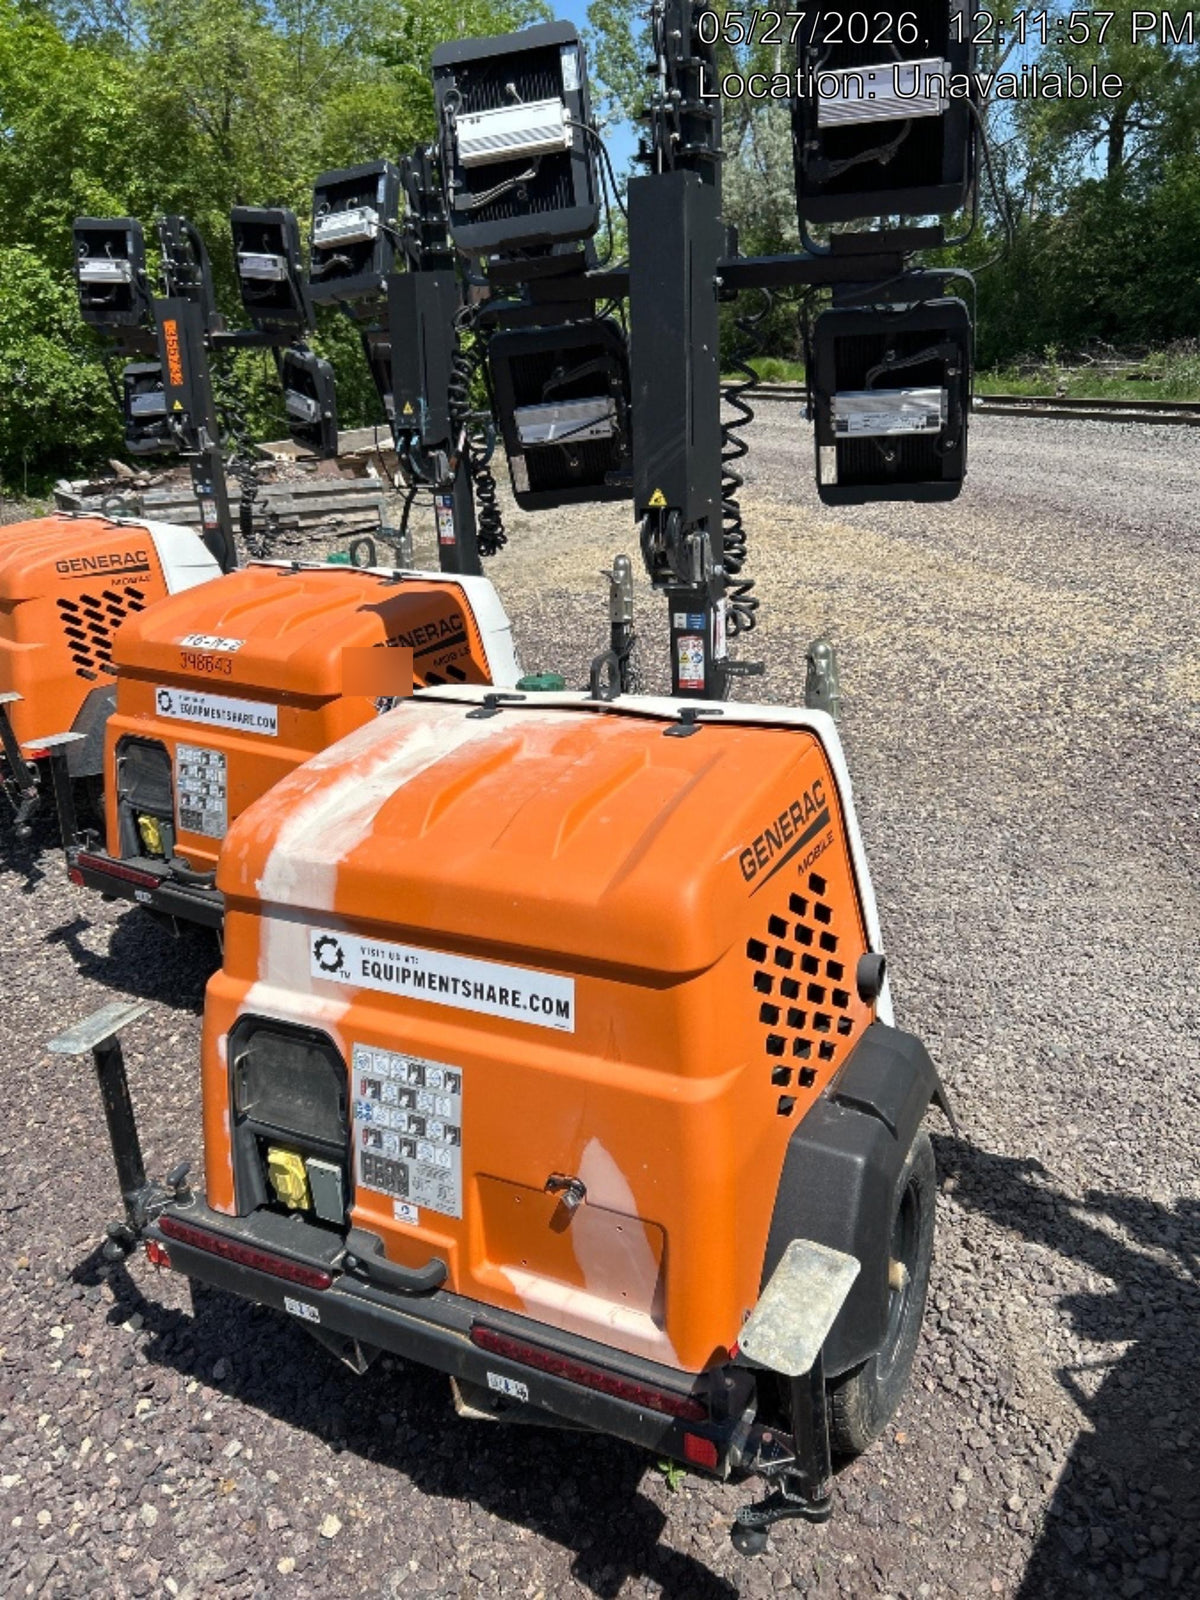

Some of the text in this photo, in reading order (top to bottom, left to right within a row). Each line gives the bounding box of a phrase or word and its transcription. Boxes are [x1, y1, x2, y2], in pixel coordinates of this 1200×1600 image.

[56, 551, 148, 573] GENERAC
[373, 614, 463, 648] ENERAC
[739, 779, 826, 882] GENERAC
[797, 830, 835, 876] MOBILE
[361, 946, 385, 959] VISIT
[362, 960, 570, 1019] EQUIPMENTSHARE.COM
